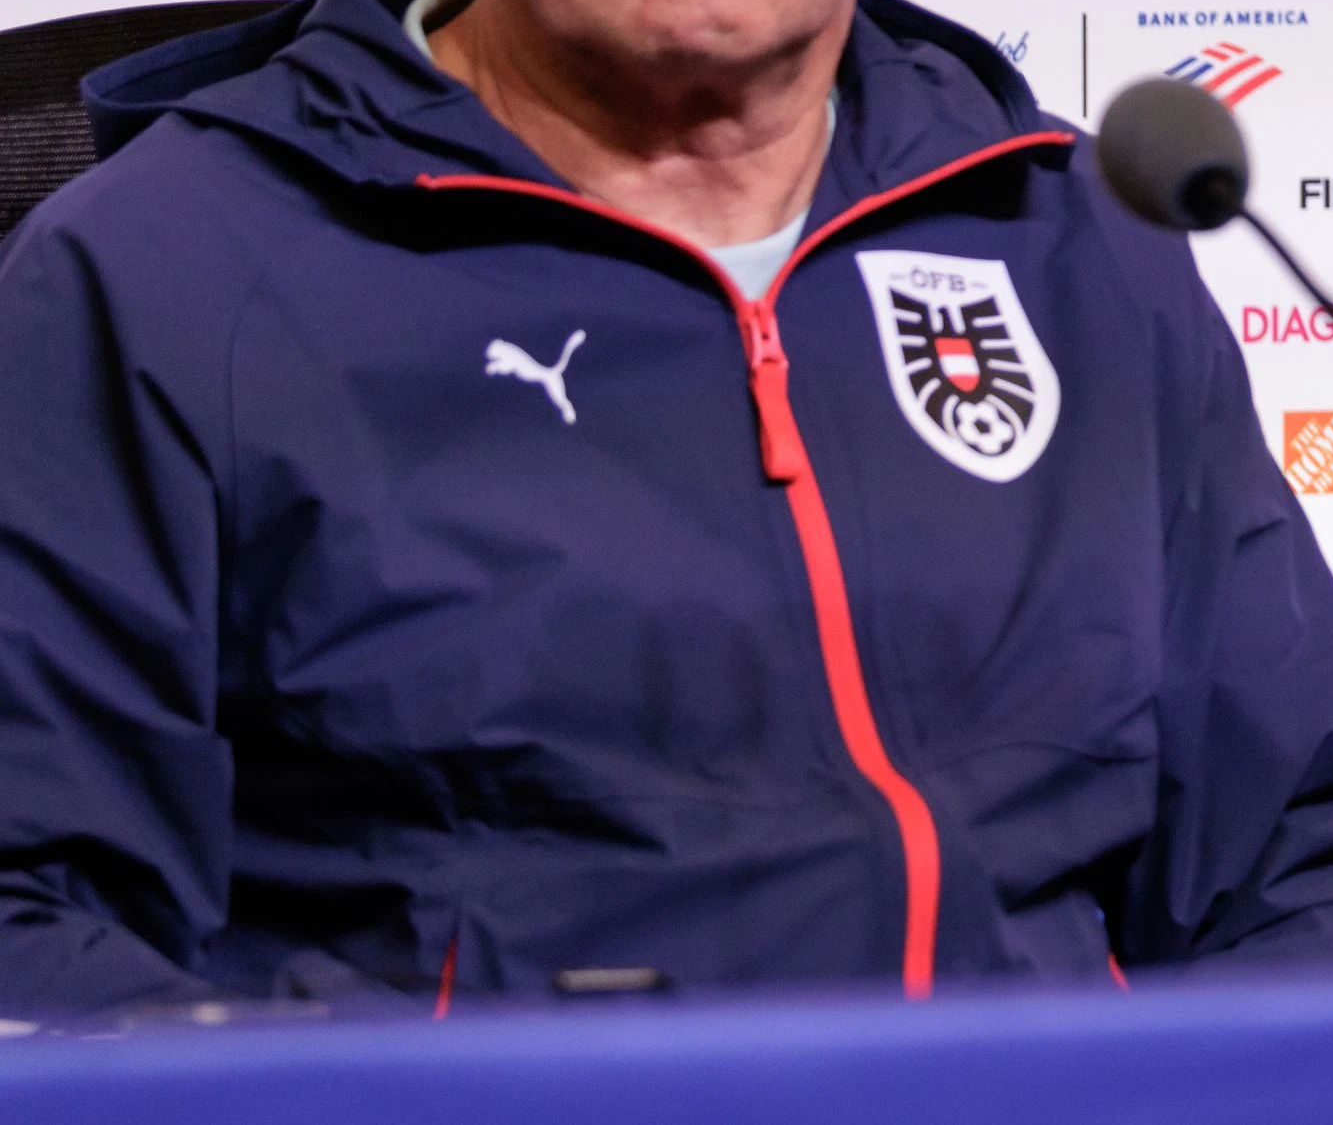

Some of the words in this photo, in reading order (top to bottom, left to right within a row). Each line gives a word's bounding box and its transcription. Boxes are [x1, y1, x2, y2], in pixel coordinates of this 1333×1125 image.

[1138, 13, 1188, 27] BANK
[1195, 11, 1217, 26] OF
[1224, 11, 1308, 25] AMERICA
